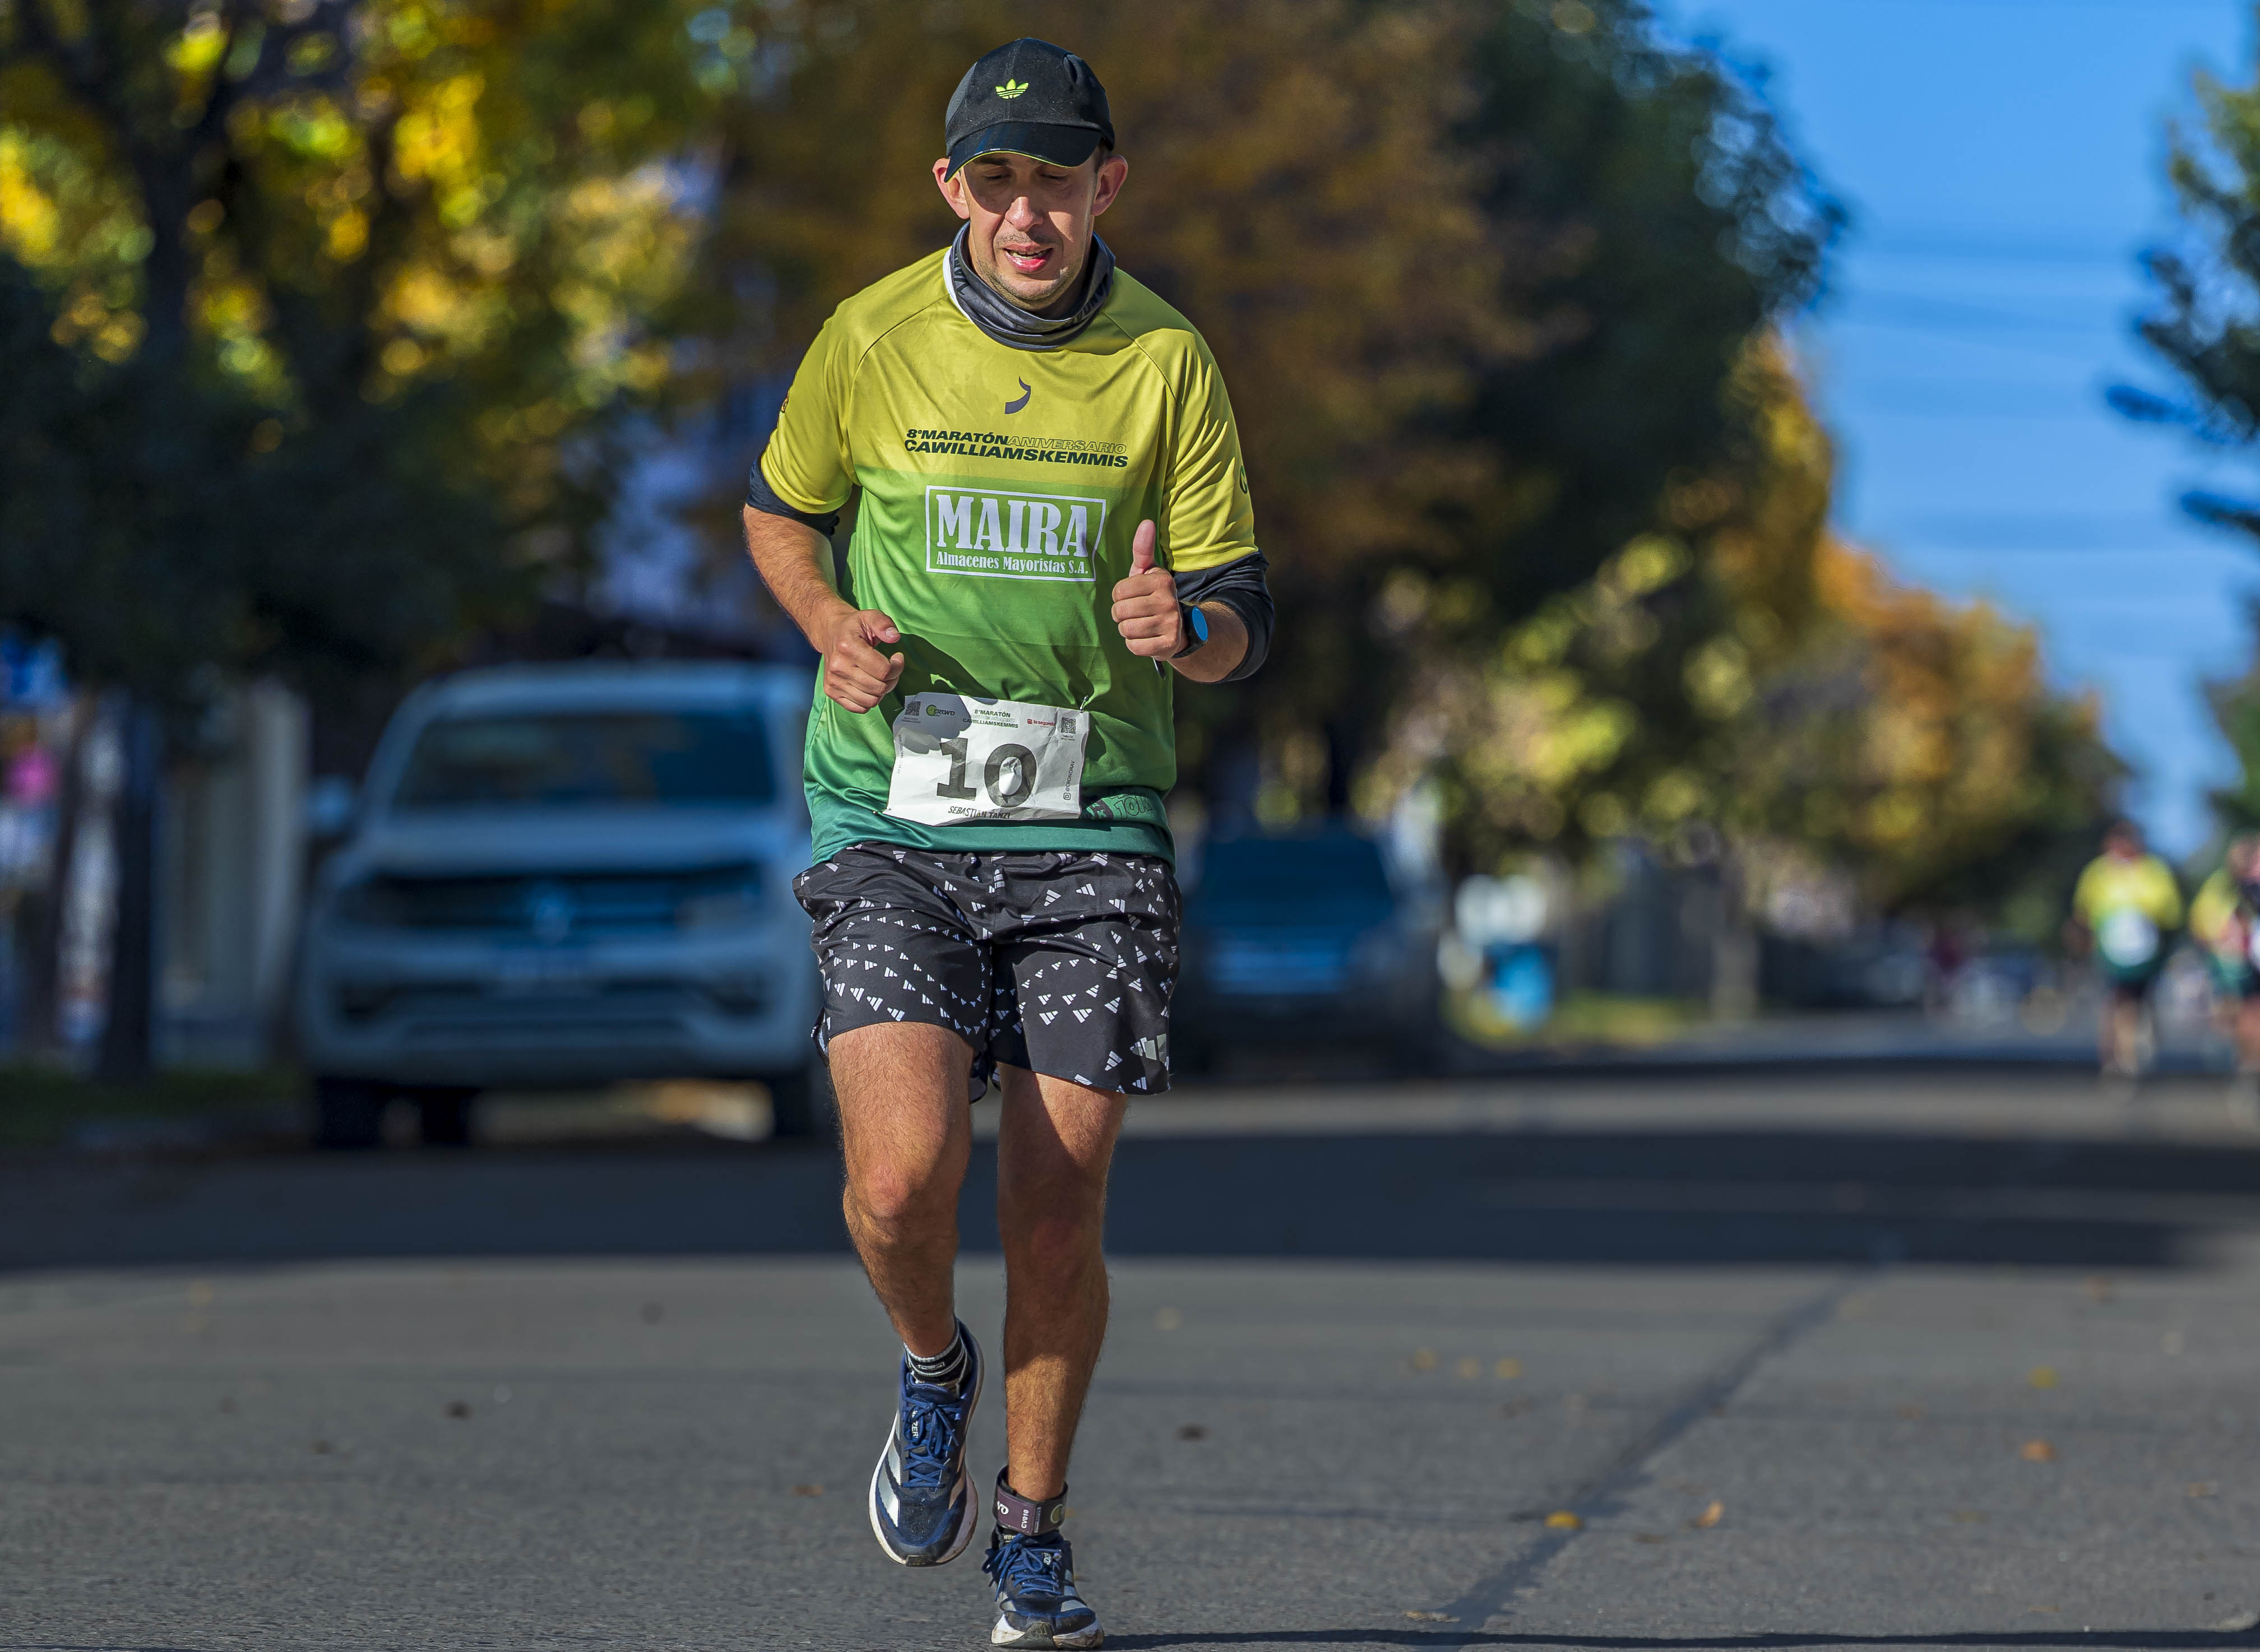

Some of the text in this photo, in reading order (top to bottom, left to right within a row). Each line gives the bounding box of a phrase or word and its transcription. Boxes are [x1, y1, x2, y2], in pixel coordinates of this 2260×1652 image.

[904, 439, 1128, 467] CAWILLIAMSKEMMIS
[936, 494, 1089, 558] MAIRA
[936, 551, 1089, 574] Almacenes Mayoristas S.A.
[937, 737, 1038, 808] 10
